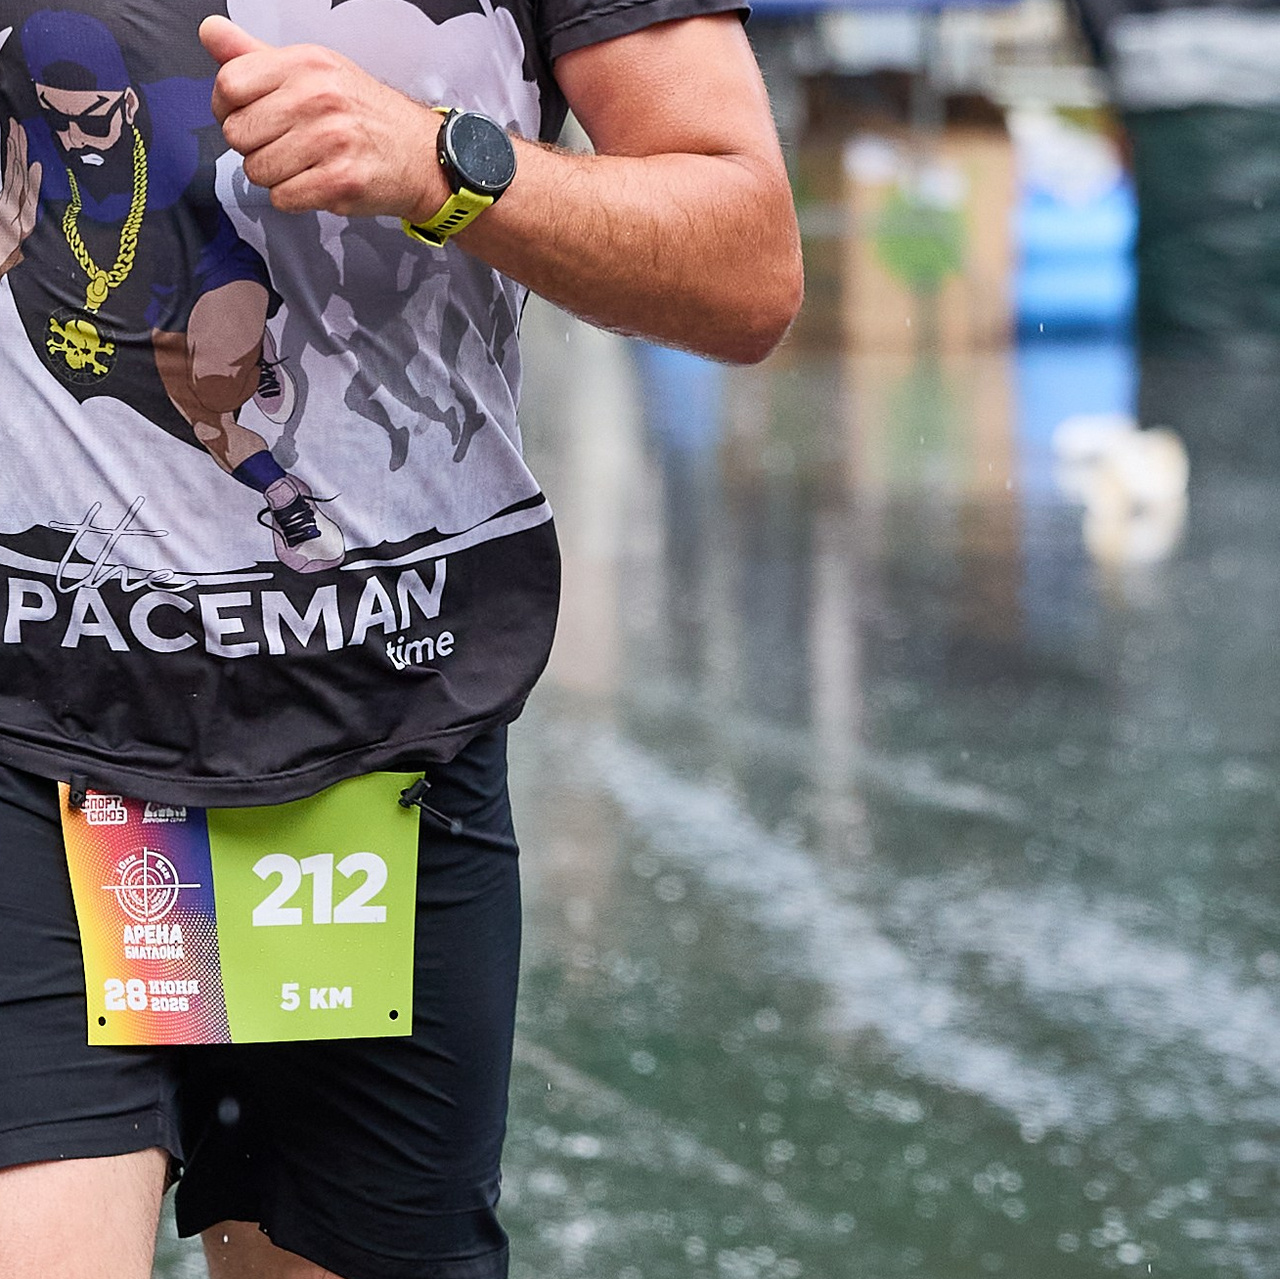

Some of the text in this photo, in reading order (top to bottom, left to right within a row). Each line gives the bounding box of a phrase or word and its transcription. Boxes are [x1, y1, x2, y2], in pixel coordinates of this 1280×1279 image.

[3, 558, 448, 659] PACEMAN
[385, 628, 455, 670] time
[90, 810, 125, 822] СОЮЗ
[251, 852, 389, 927] 212
[123, 924, 184, 945] АРЕНА
[124, 945, 185, 960] БИАТЛОНА
[104, 978, 200, 1011] 28 ИЮНЯ
[151, 997, 190, 1012] 2026
[280, 983, 300, 1011] 5
